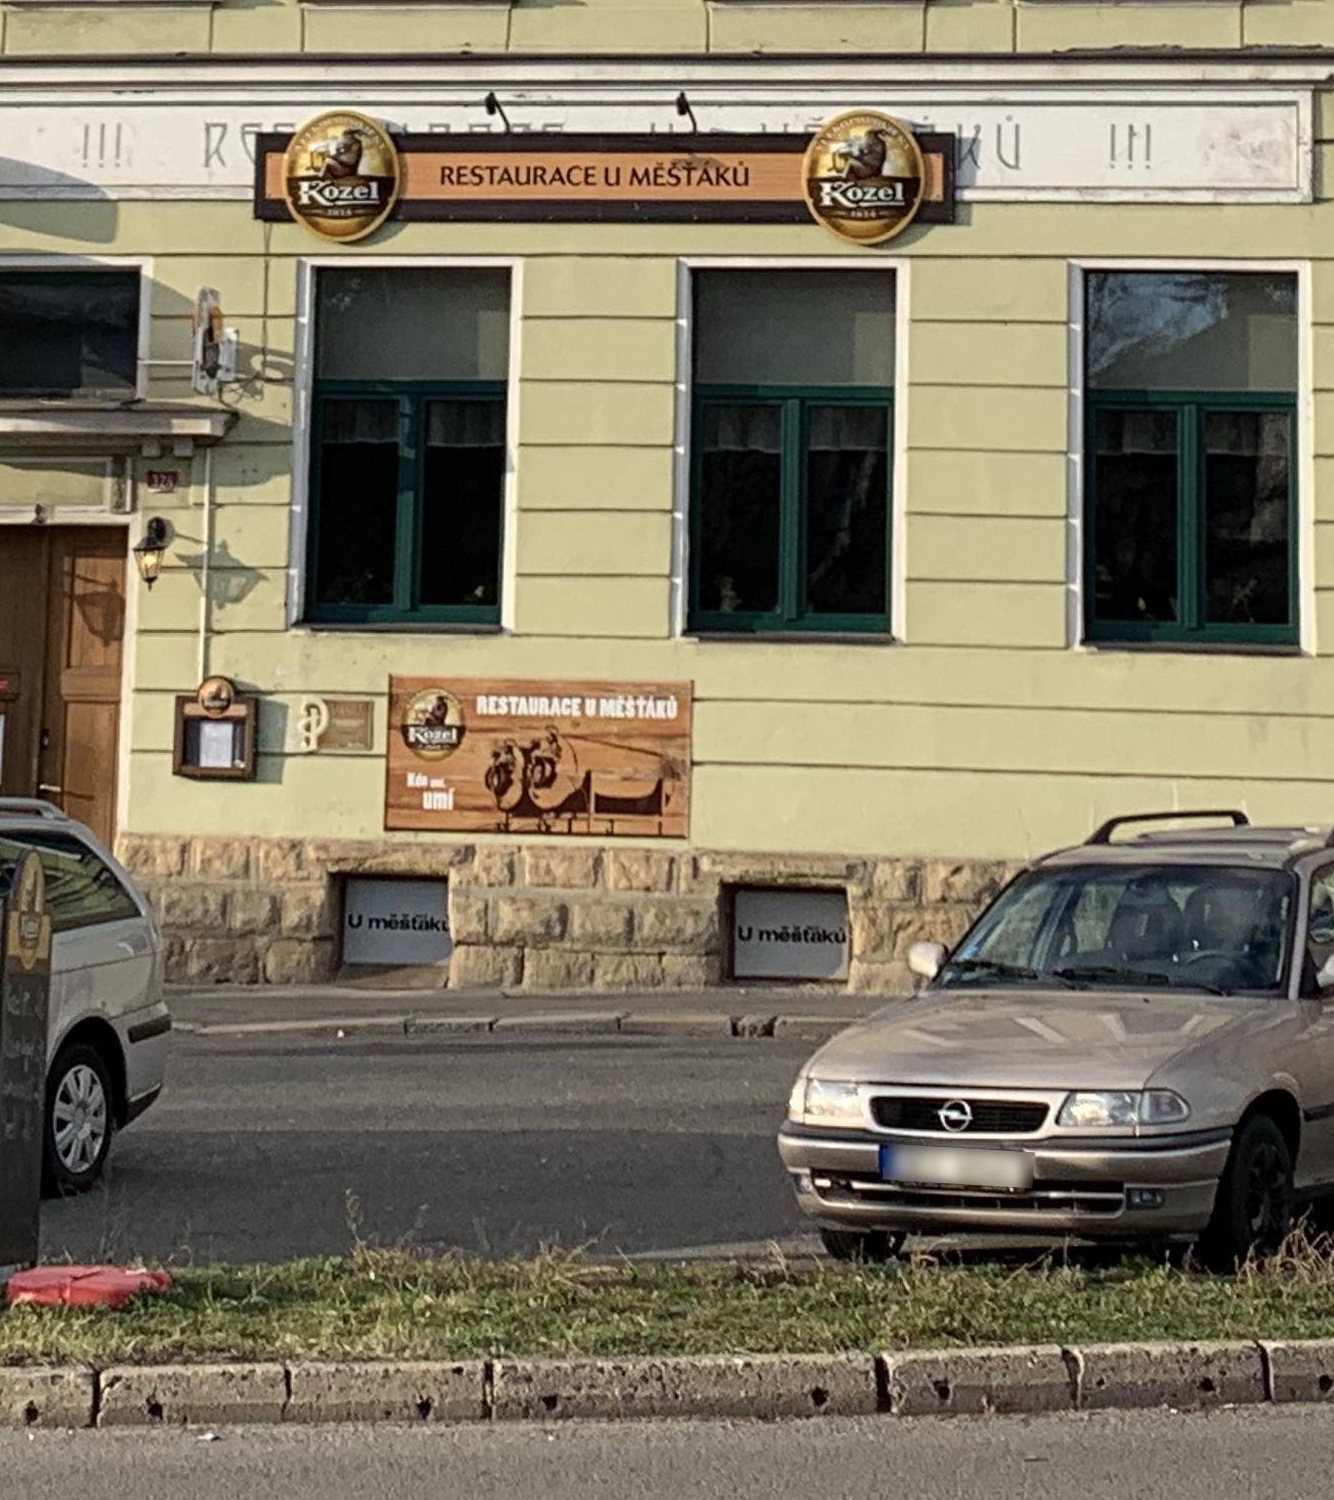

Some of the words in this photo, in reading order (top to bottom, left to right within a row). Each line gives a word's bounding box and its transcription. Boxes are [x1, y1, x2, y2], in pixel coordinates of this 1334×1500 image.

[439, 165, 596, 187] RESTAURACE
[603, 167, 620, 187] U
[298, 180, 380, 207] Kozel
[819, 181, 905, 208] Kozel
[476, 695, 581, 717] RESTAURACE
[584, 698, 597, 717] U
[408, 726, 458, 744] Kozel
[347, 913, 363, 929] U
[737, 925, 753, 941] U
